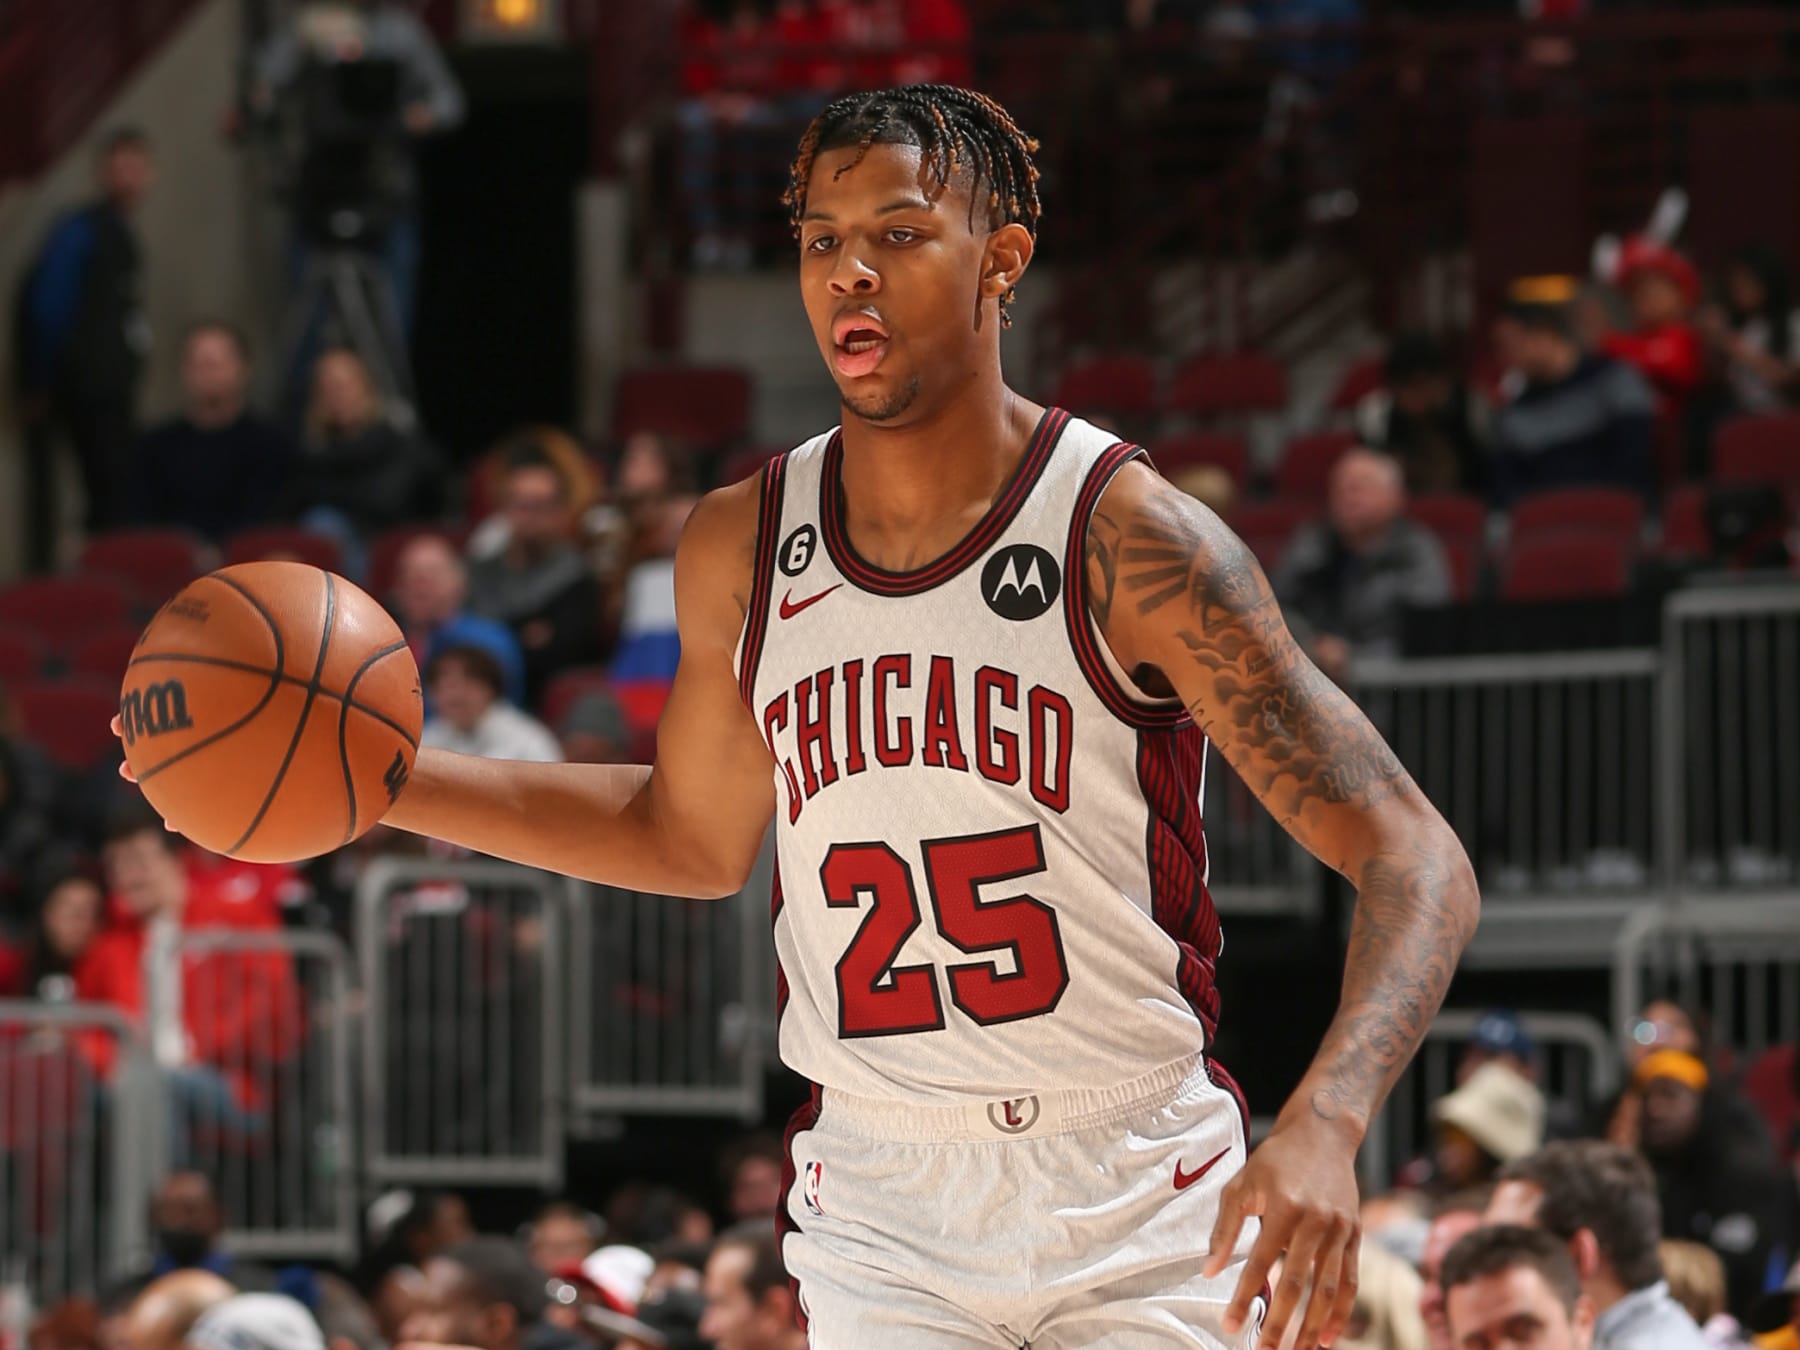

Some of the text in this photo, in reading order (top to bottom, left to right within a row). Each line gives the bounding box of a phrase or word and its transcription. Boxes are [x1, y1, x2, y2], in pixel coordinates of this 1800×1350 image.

[786, 533, 810, 573] 6
[763, 652, 1074, 827] CHICAGO
[819, 823, 1070, 1040] 25
